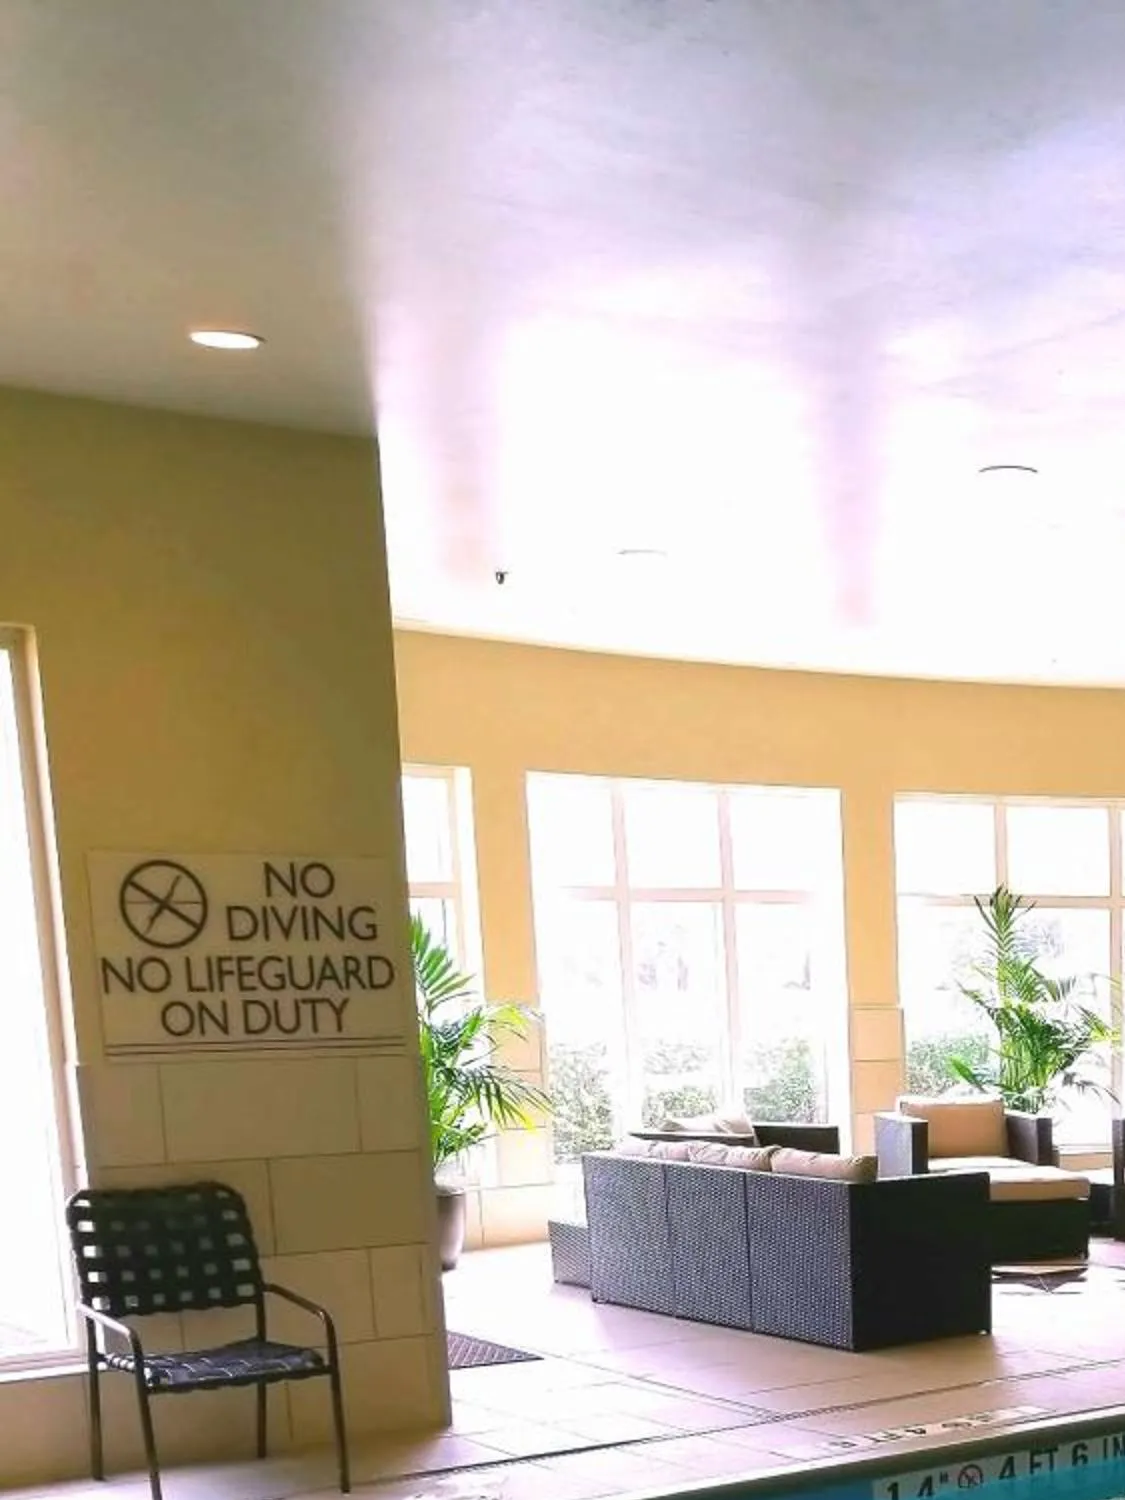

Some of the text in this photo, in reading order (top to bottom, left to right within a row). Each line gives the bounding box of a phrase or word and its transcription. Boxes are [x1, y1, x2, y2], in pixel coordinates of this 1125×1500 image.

[262, 862, 335, 898] NO
[226, 904, 378, 942] DIVING
[101, 955, 395, 994] NO LIFEGUARD
[160, 997, 350, 1037] ON DUTY
[1029, 1446, 1059, 1475] FT
